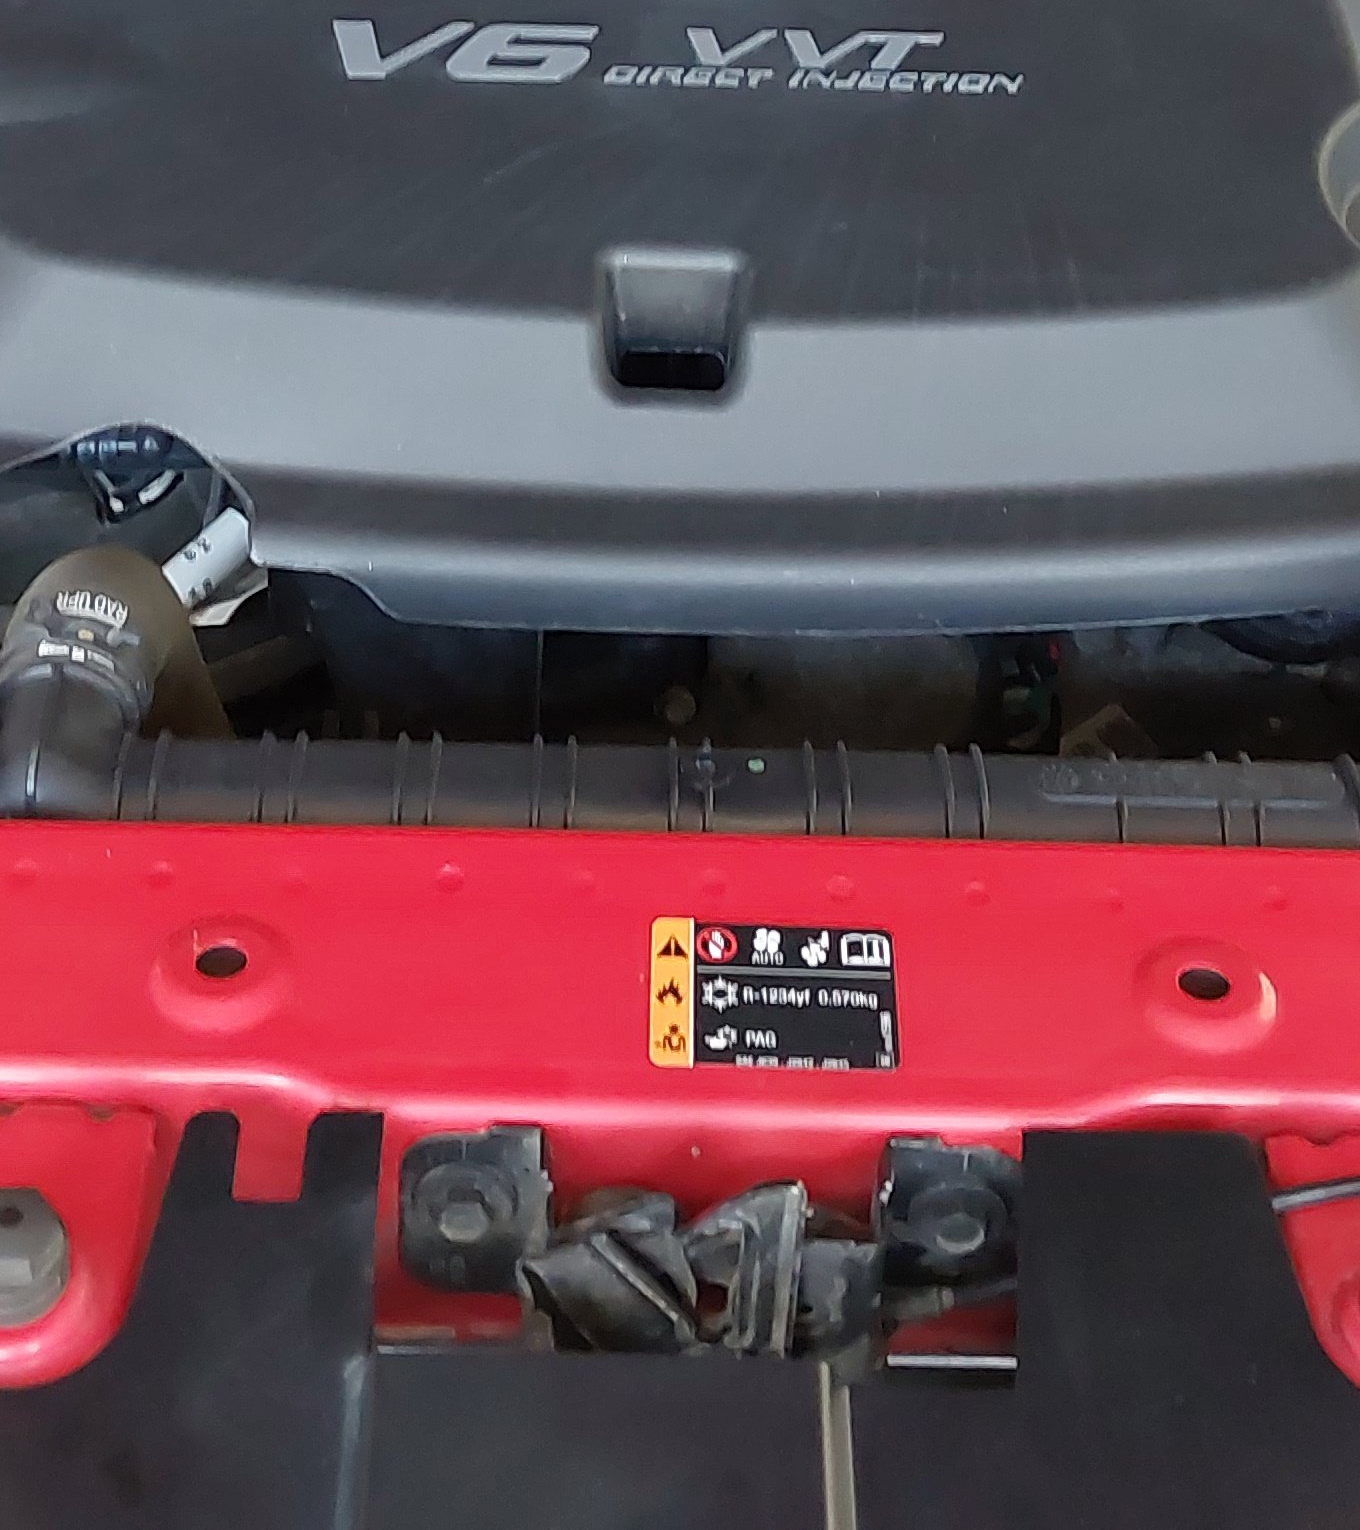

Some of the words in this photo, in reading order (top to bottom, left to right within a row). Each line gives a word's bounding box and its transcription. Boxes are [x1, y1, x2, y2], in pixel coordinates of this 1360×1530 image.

[332, 19, 601, 84] V6
[685, 27, 945, 70] VVT
[602, 65, 773, 88] DIRECT
[787, 68, 1024, 96] INJECTION
